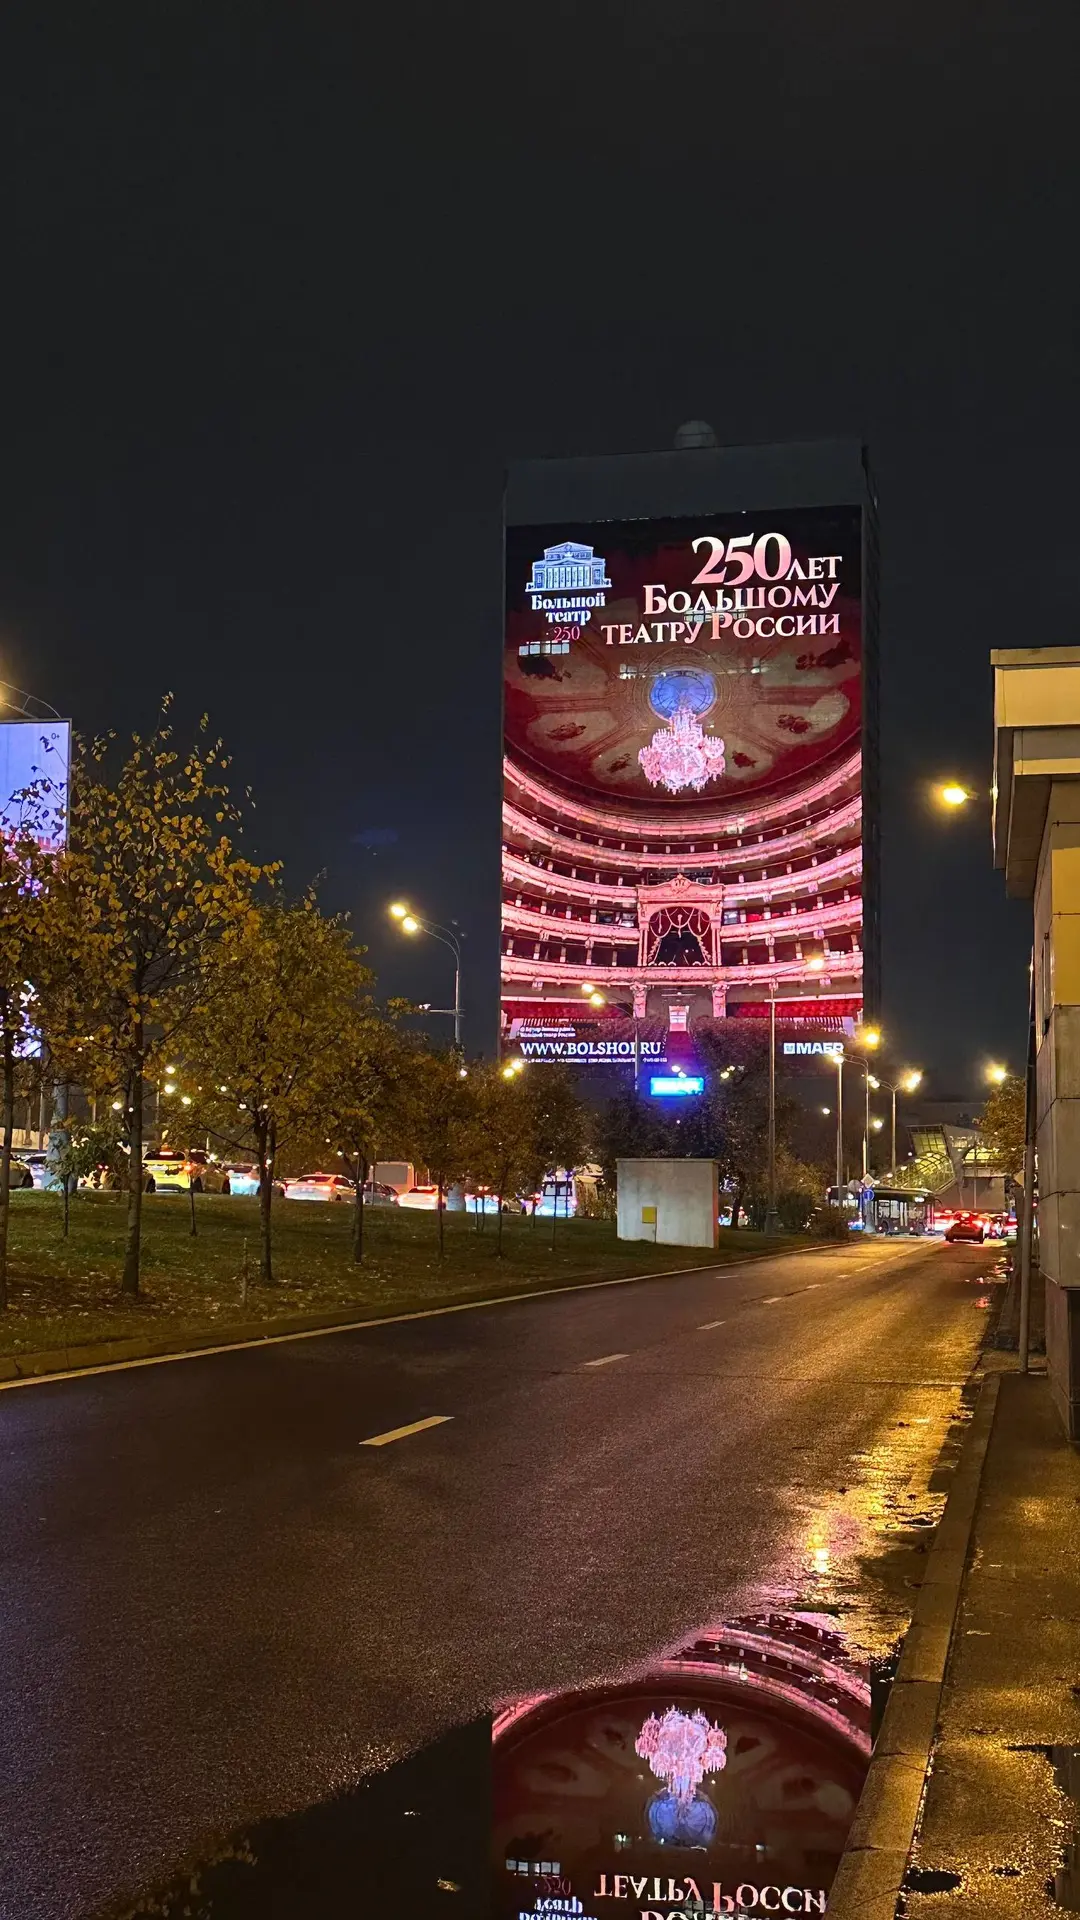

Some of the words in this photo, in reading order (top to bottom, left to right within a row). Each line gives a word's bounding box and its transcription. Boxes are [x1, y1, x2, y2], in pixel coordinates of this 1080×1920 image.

[531, 592, 606, 610] Большой
[545, 610, 592, 626] театр
[553, 626, 581, 641] 250
[600, 619, 705, 646] ТЕАТРУ
[710, 612, 841, 640] РОССИИ
[520, 1041, 662, 1055] WWW.BOLSHOIRU
